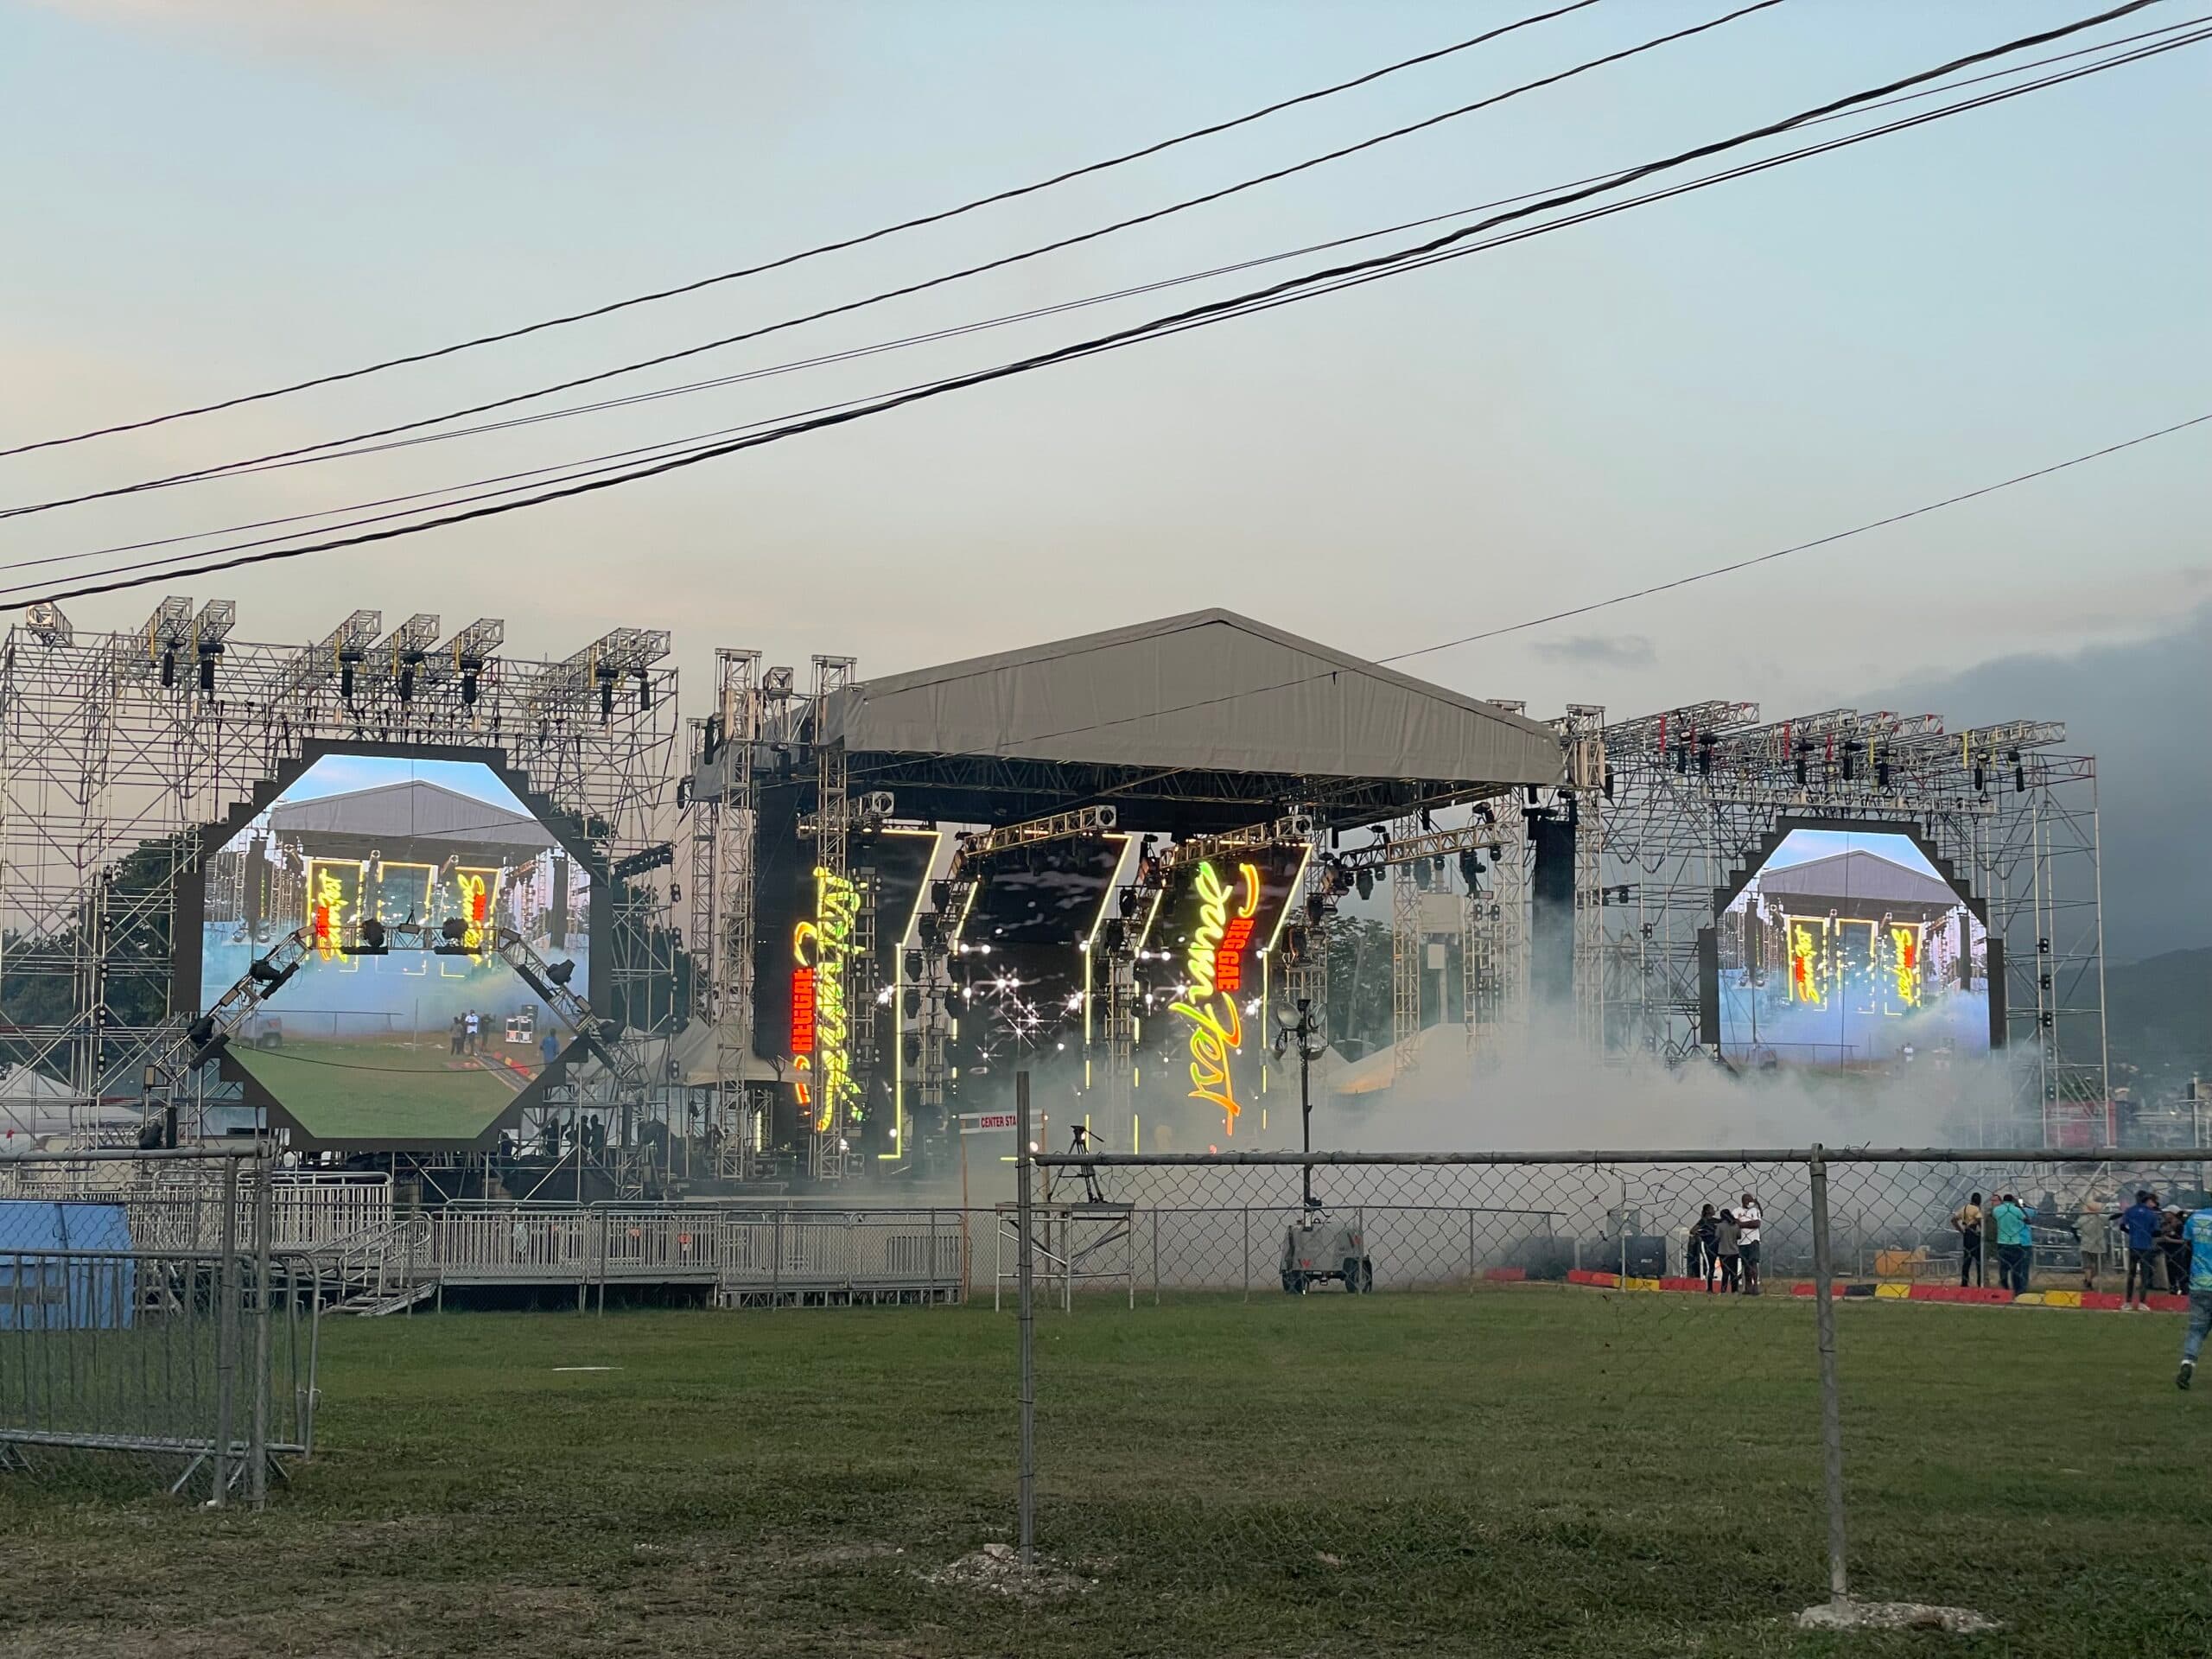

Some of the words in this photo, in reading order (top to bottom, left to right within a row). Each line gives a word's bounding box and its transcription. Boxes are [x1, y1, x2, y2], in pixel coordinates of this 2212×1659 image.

[1217, 918, 1253, 991] REGGAE
[791, 968, 813, 1052] REGGAE
[981, 1116, 1004, 1128] CENTER
[1006, 1116, 1018, 1126] STA
